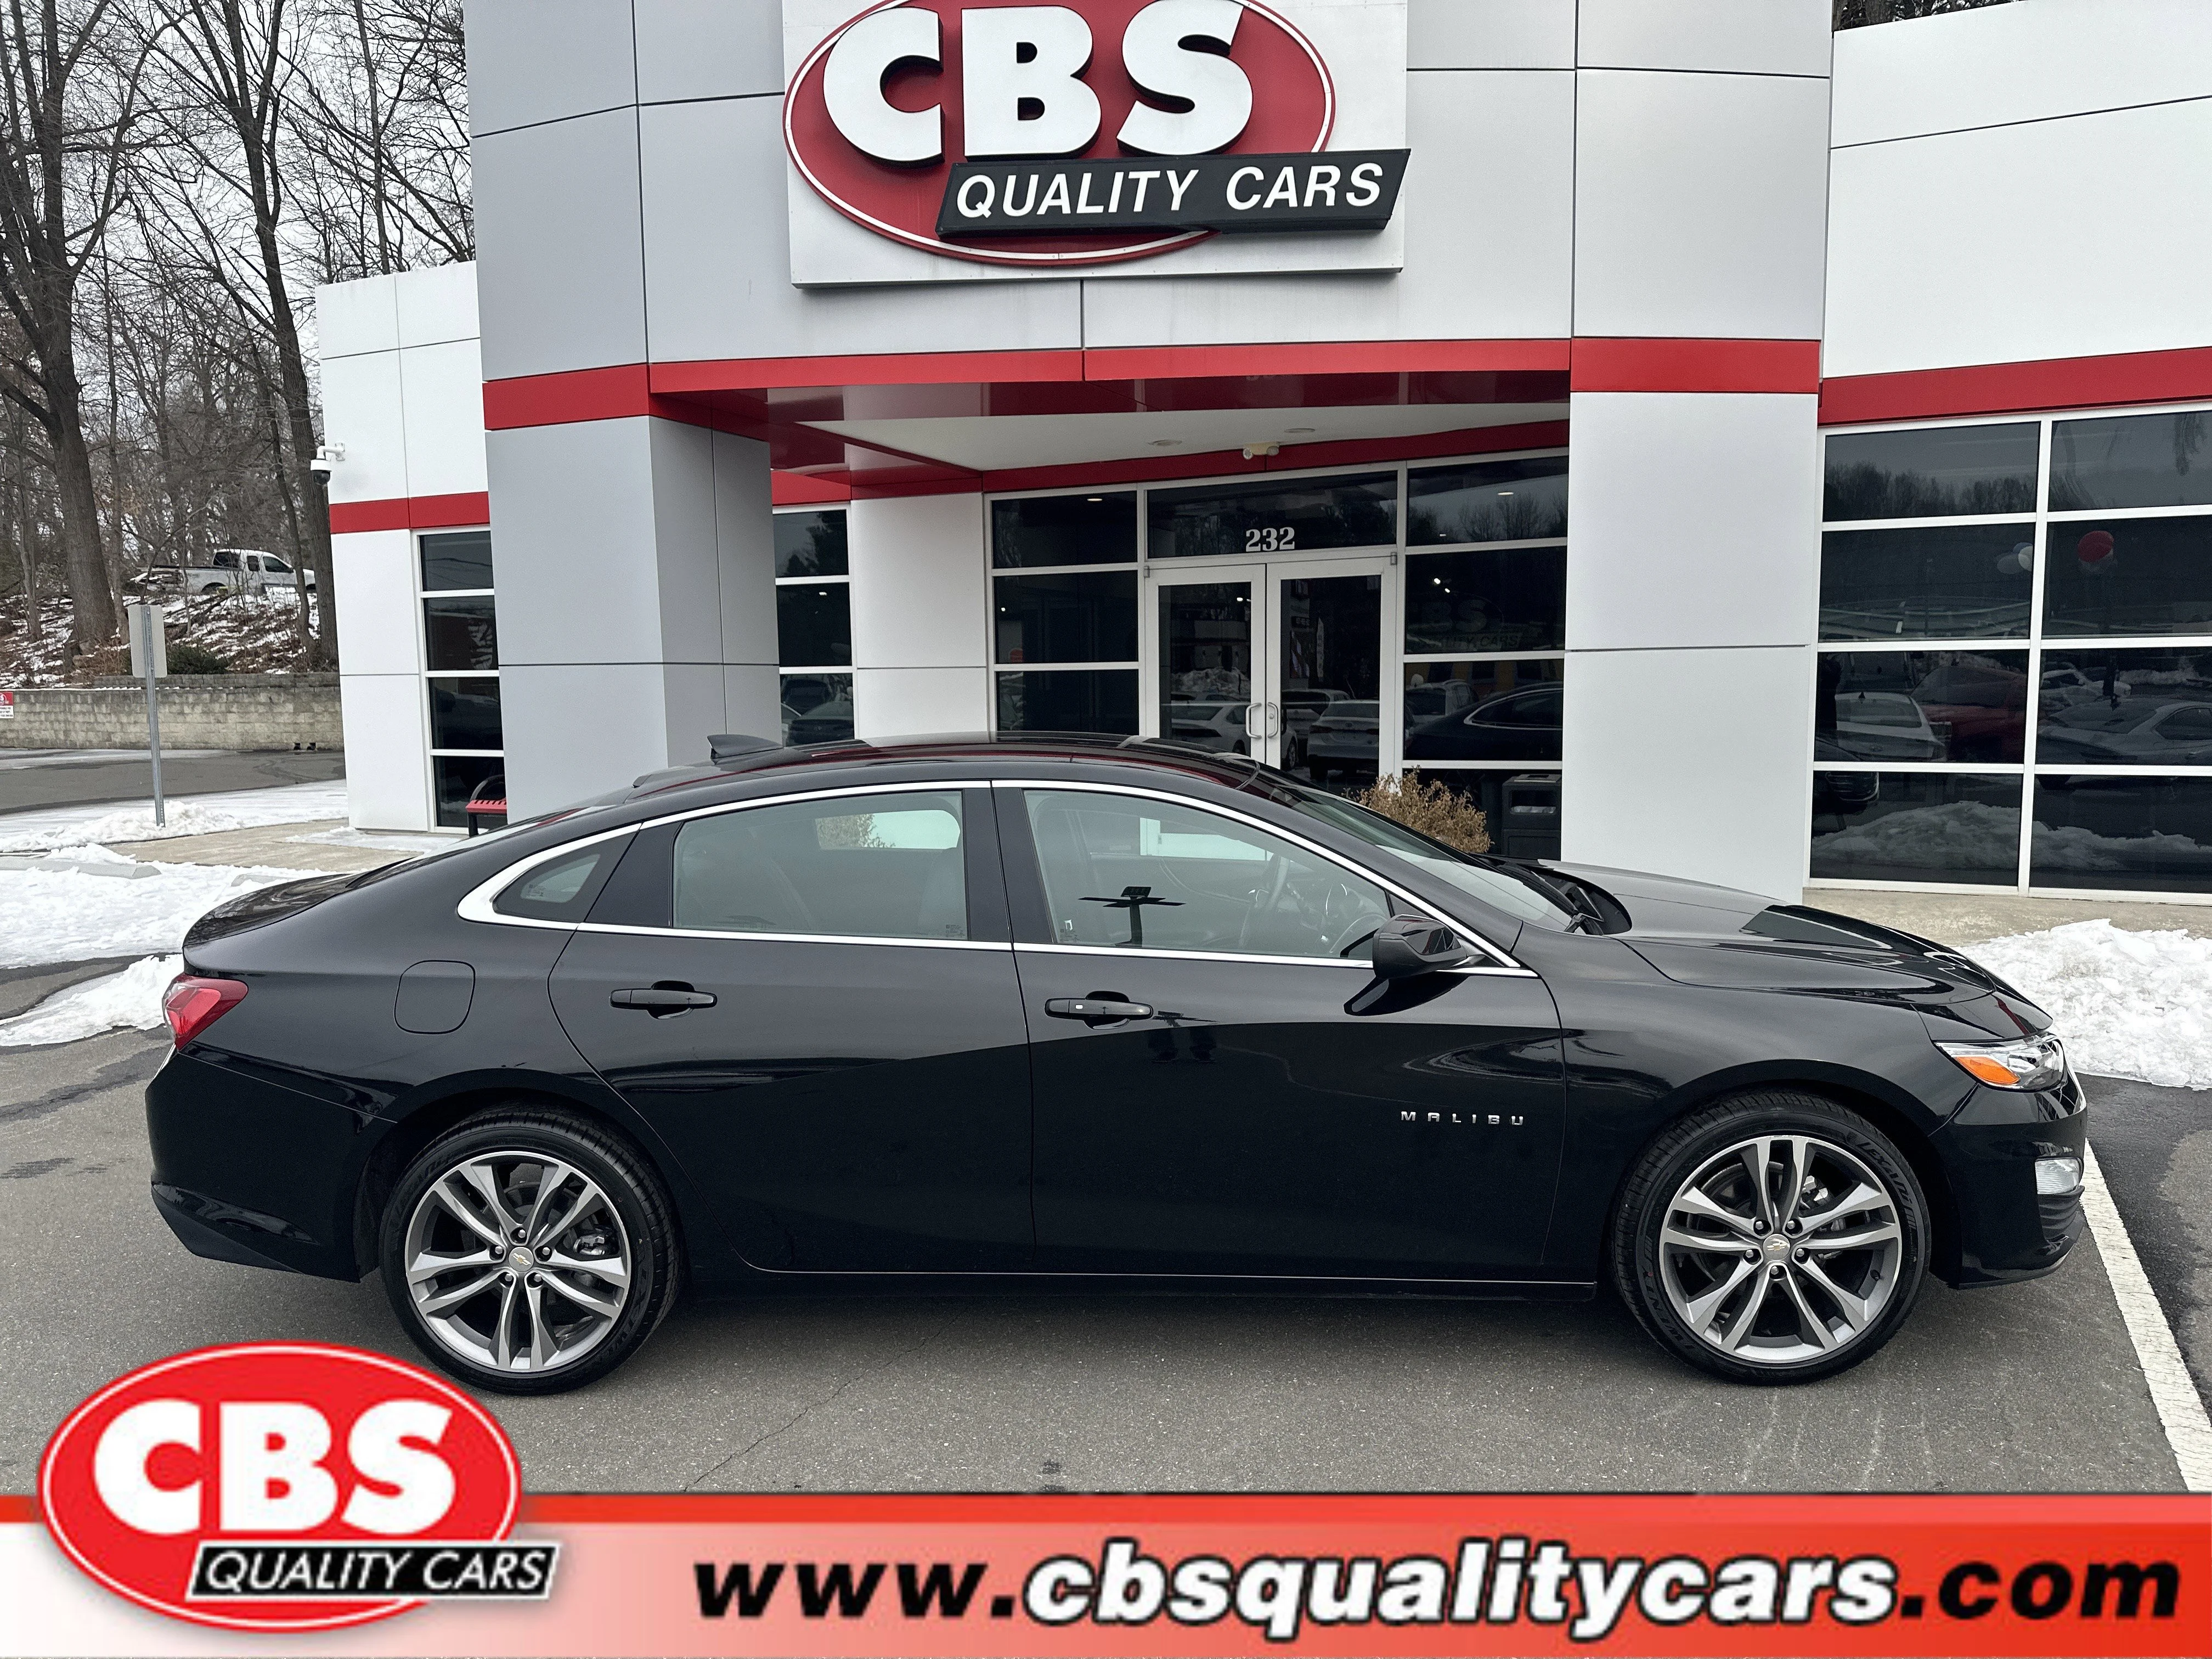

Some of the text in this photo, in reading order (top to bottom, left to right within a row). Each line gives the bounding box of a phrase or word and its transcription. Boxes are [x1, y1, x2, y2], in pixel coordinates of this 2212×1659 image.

[822, 0, 1255, 166] CBS
[956, 162, 1385, 219] QUALITY CARS
[1245, 527, 1295, 552] 232
[1401, 1111, 1523, 1125] MALIBU
